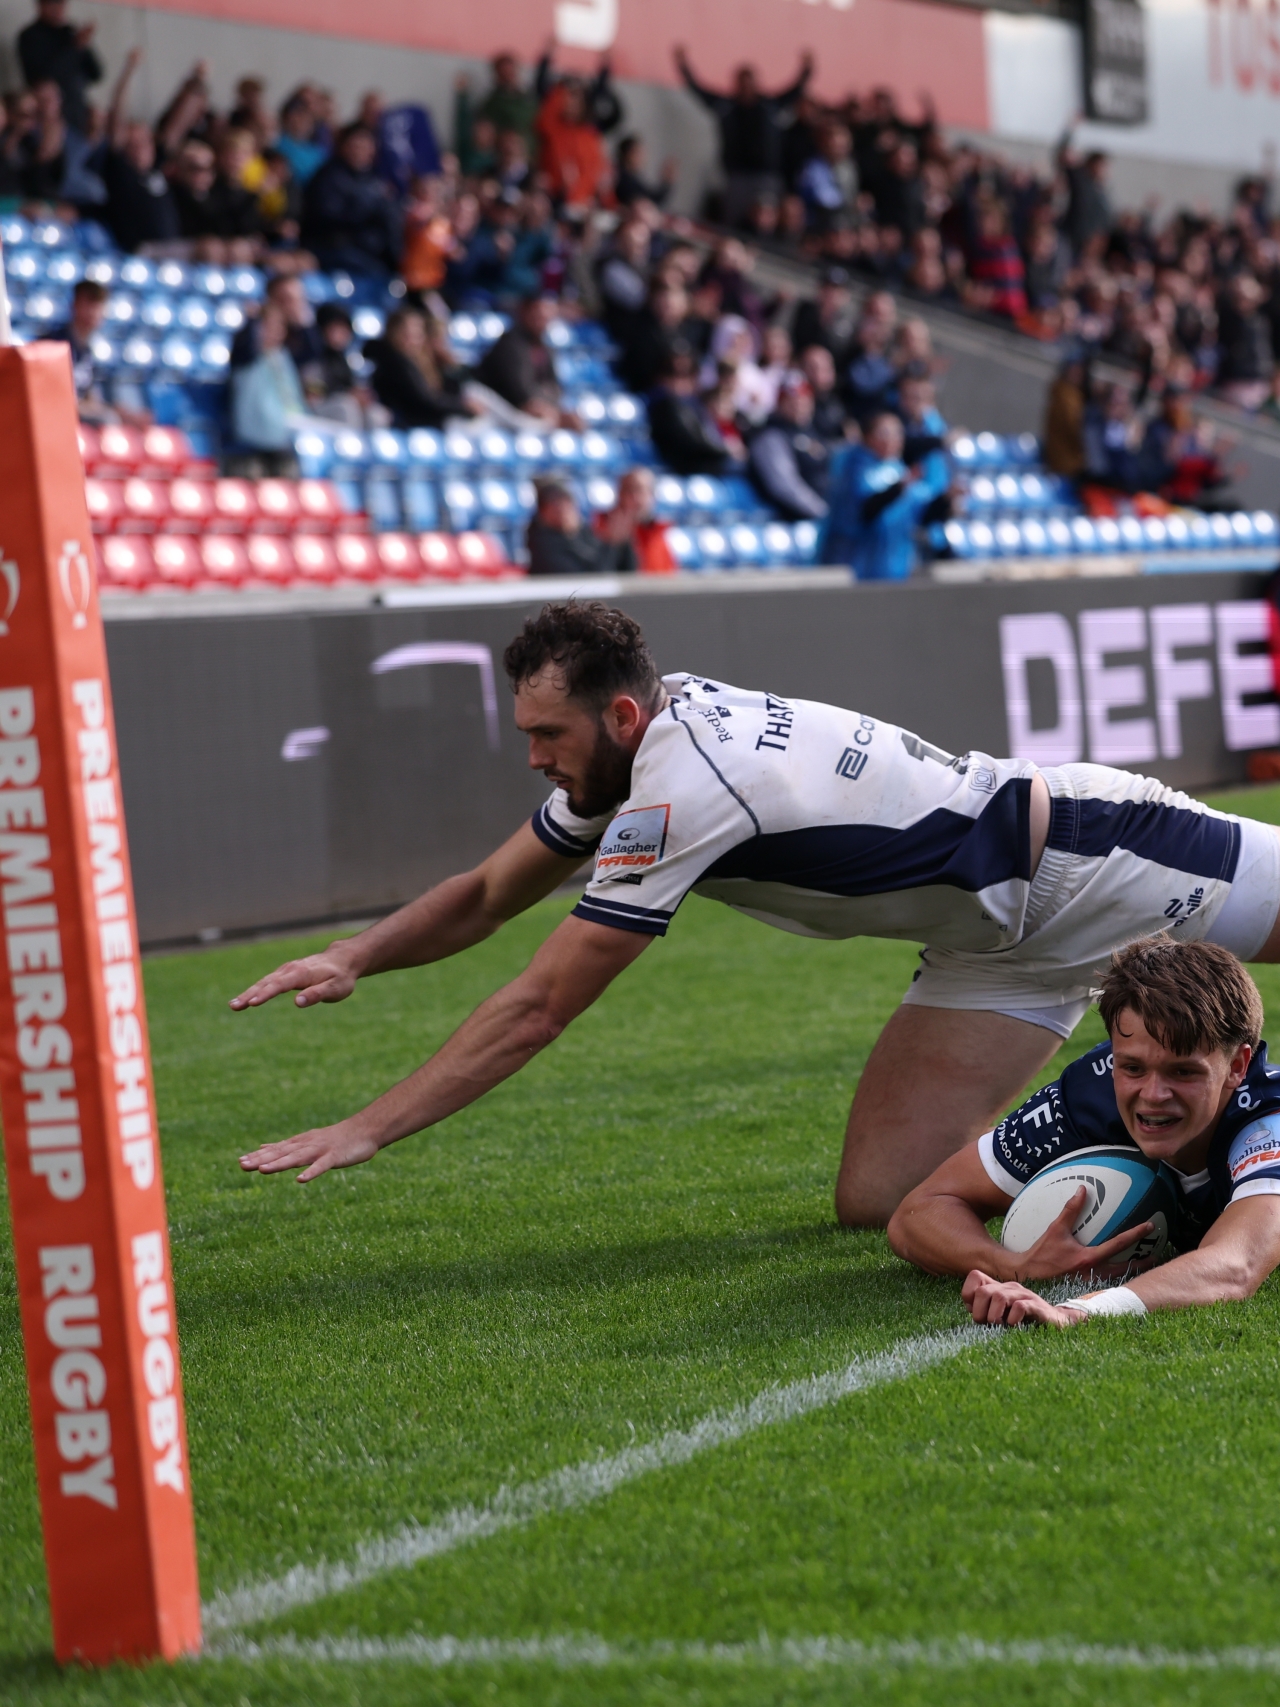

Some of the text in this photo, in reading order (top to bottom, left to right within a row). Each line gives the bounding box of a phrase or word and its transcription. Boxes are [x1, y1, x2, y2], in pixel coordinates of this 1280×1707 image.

[598, 855, 656, 868] PREM
[601, 843, 657, 856] Gallagher
[0, 686, 118, 1510] PREMIERSHIP RUGBY
[72, 679, 184, 1494] PREMIERSHIP RUGBY
[1022, 1101, 1053, 1128] F
